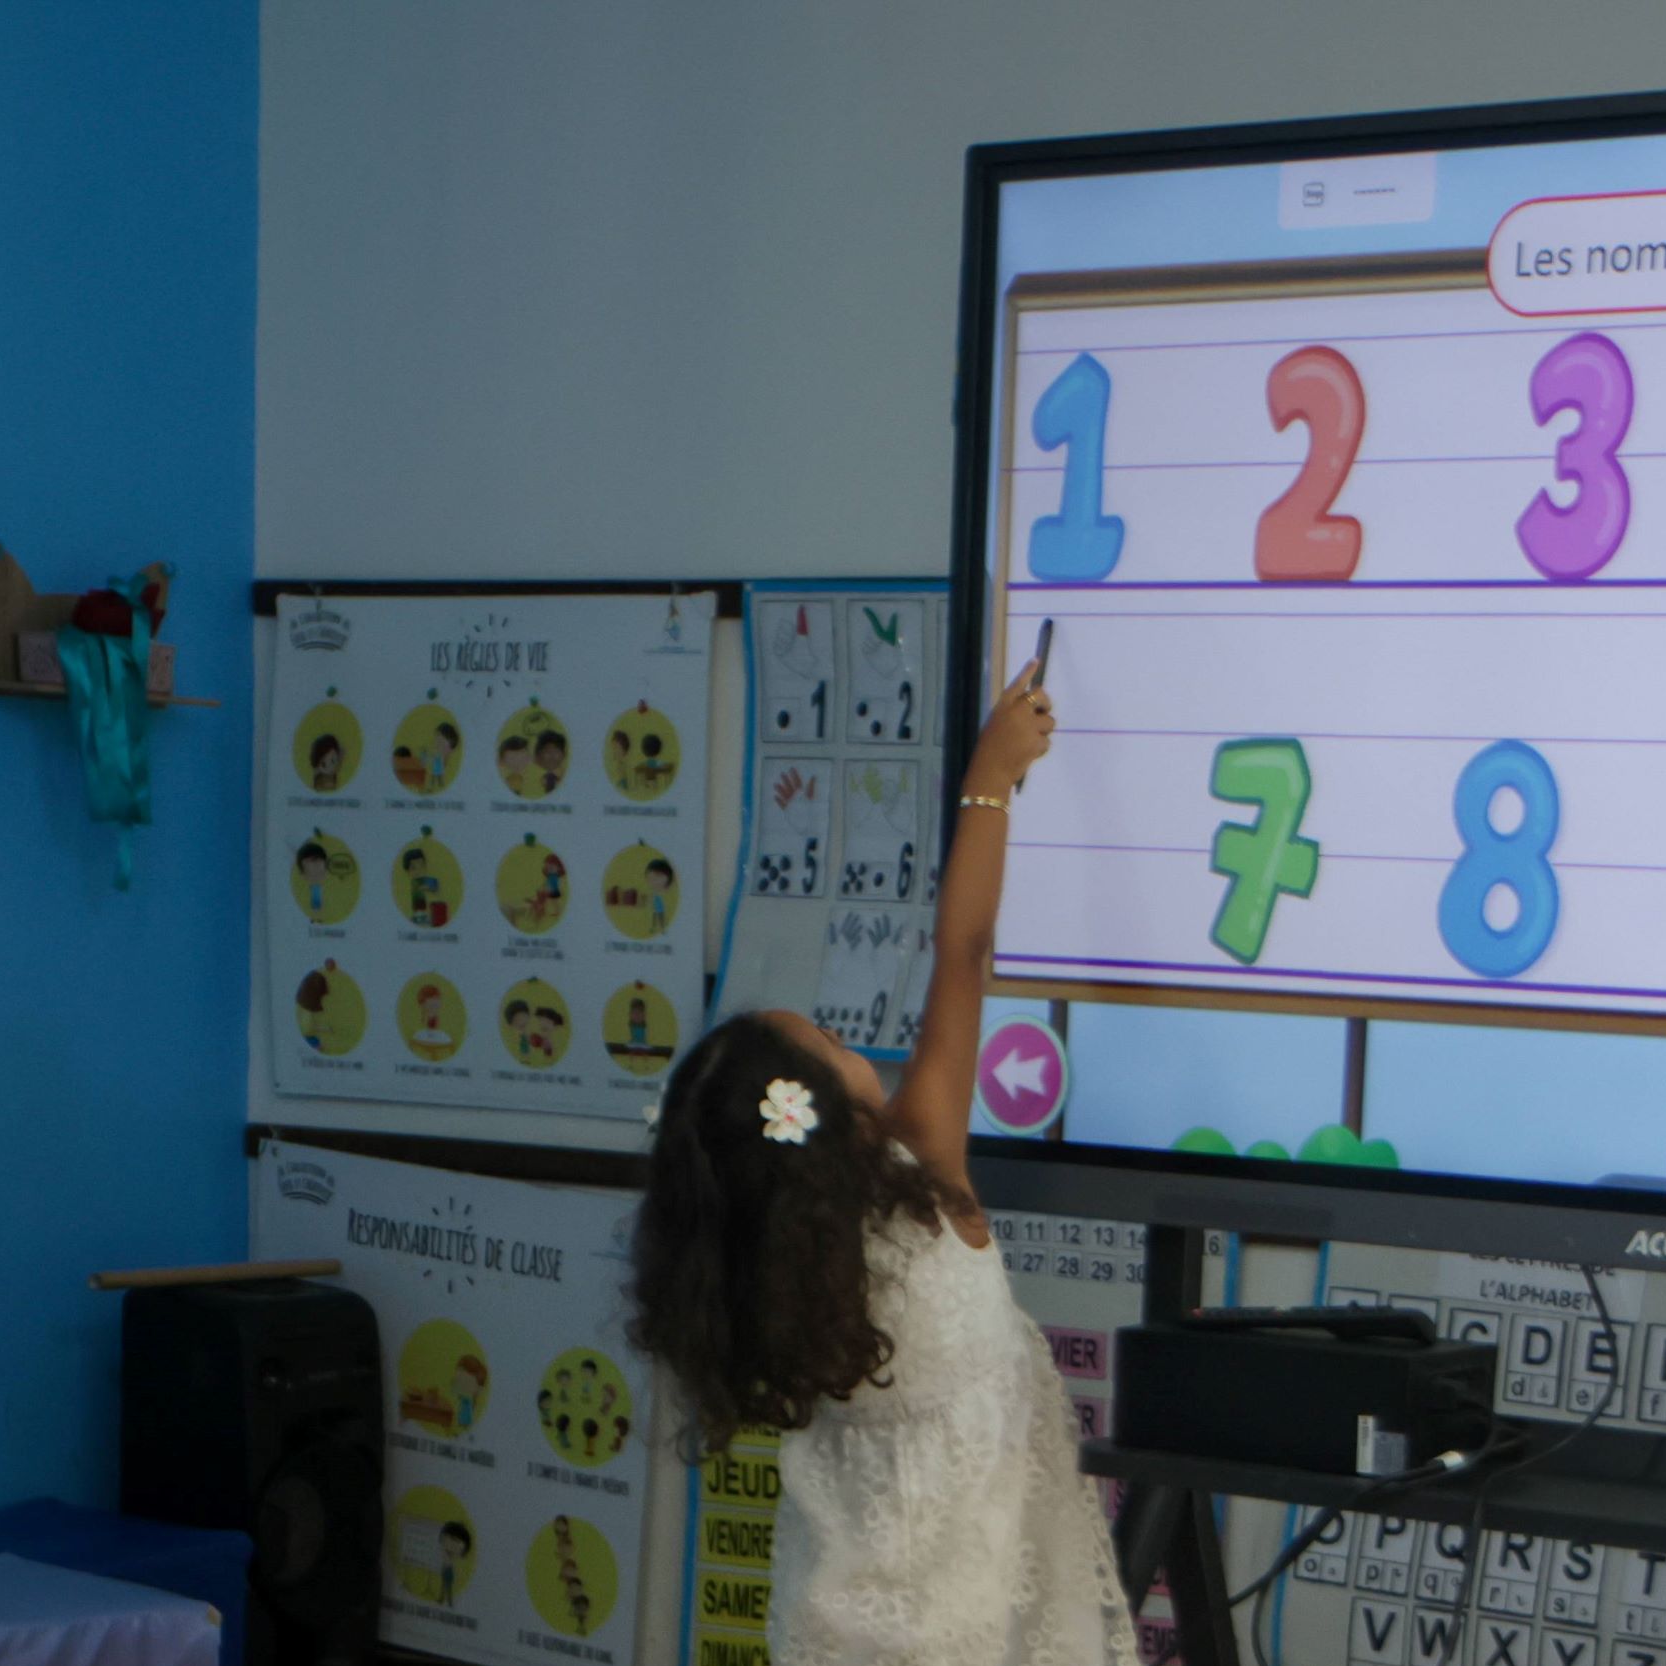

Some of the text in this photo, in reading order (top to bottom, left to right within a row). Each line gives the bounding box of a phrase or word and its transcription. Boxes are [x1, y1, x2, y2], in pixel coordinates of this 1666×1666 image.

[1514, 240, 1573, 278] Les
[1026, 350, 1126, 584] 1
[1253, 344, 1366, 583] 2
[1515, 331, 1635, 582] 3
[430, 641, 451, 673] LES
[504, 640, 522, 673] DE
[527, 641, 550, 673] VIE
[811, 679, 913, 740] 1 2
[802, 836, 914, 899] 5 6
[1208, 735, 1320, 967] 7
[1437, 737, 1560, 978] 8
[863, 989, 888, 1046] 9
[347, 1207, 564, 1283] RESPONSABILITÉS DE CLASSE
[1024, 1221, 1045, 1242] 11
[1058, 1223, 1082, 1245] 12
[1093, 1226, 1115, 1247] 13
[1022, 1252, 1045, 1273] 27
[1057, 1255, 1080, 1277] 28
[1090, 1259, 1114, 1282] 29
[1048, 1335, 1098, 1369] VIER
[1522, 1324, 1553, 1365] D
[1585, 1330, 1616, 1374] E
[1376, 1514, 1406, 1550] P
[1498, 1532, 1534, 1572] R
[1562, 1540, 1594, 1582] S
[1637, 1551, 1666, 1596] T
[1361, 1606, 1397, 1652] V
[1417, 1615, 1462, 1661] W
